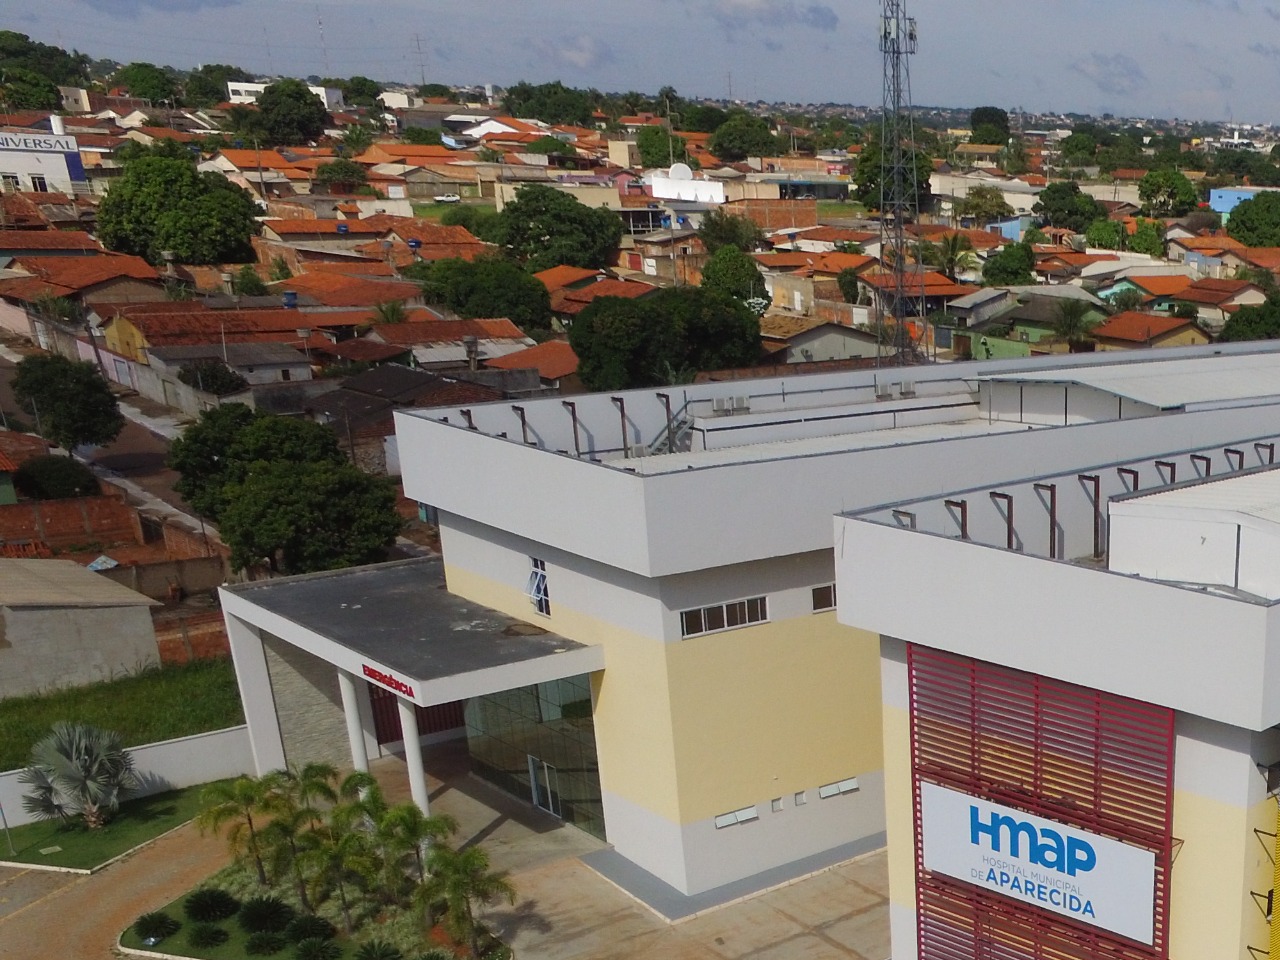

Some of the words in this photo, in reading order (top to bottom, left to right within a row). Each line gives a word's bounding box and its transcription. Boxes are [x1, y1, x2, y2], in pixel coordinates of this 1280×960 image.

[970, 867, 984, 881] DE
[985, 867, 1096, 919] APARECIDA
[981, 854, 1029, 878] HOSPITAL
[1030, 864, 1083, 897] MUNICIPAL
